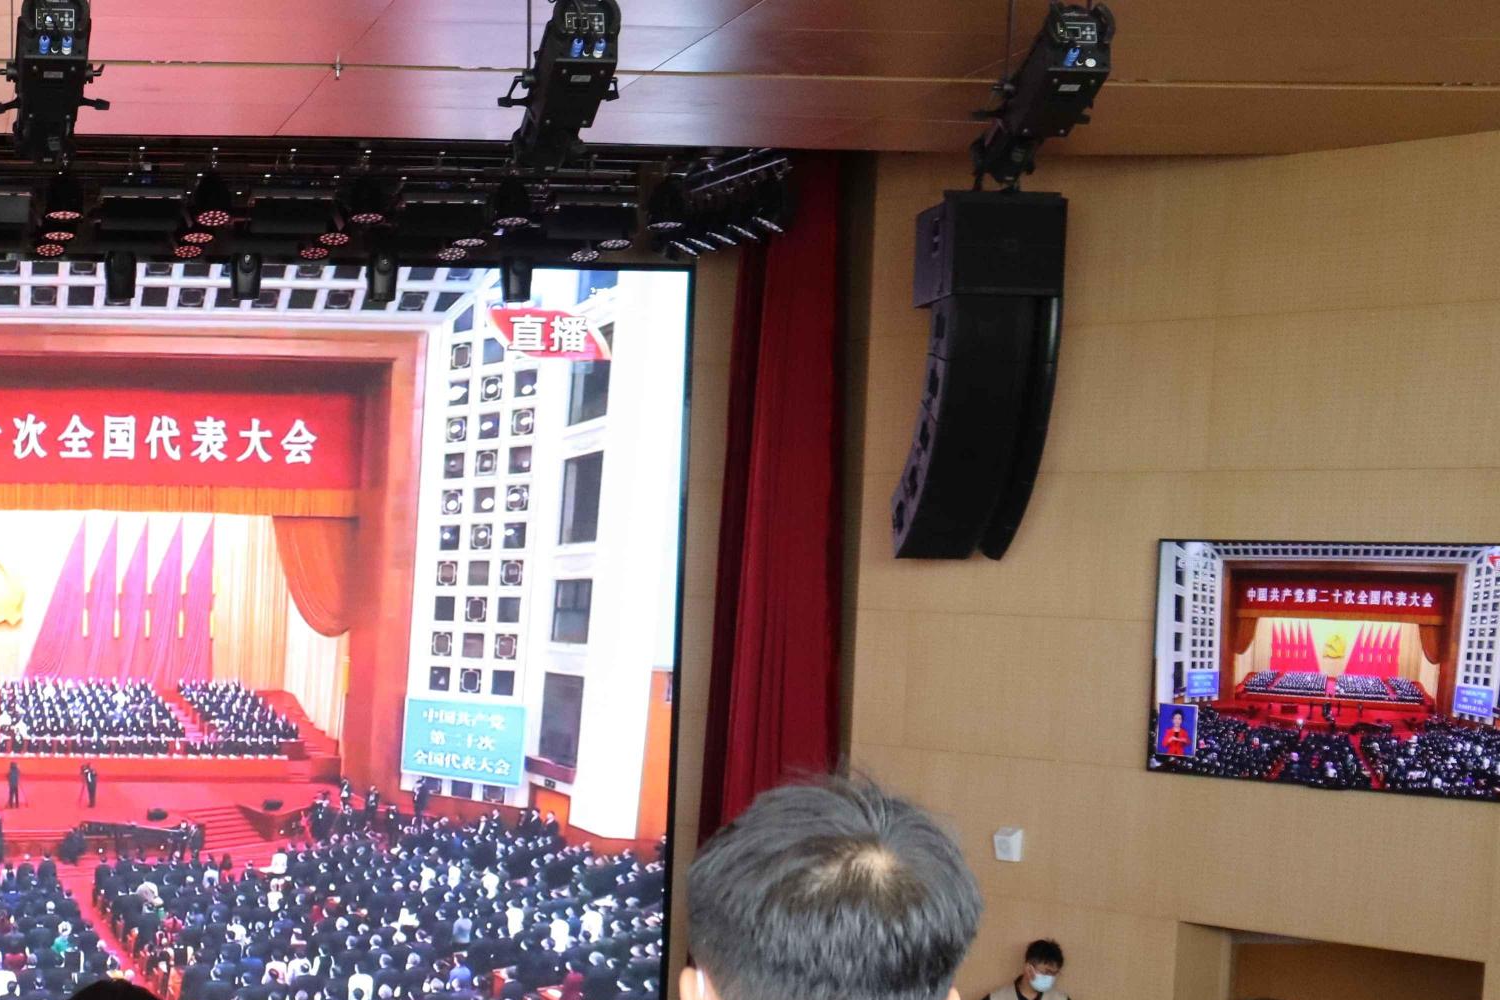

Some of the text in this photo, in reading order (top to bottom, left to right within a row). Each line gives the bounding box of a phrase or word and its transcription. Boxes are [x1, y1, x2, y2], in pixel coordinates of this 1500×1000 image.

[507, 314, 589, 353] 直播
[1246, 587, 1434, 608] 中国共产党第二十次全国代表大会
